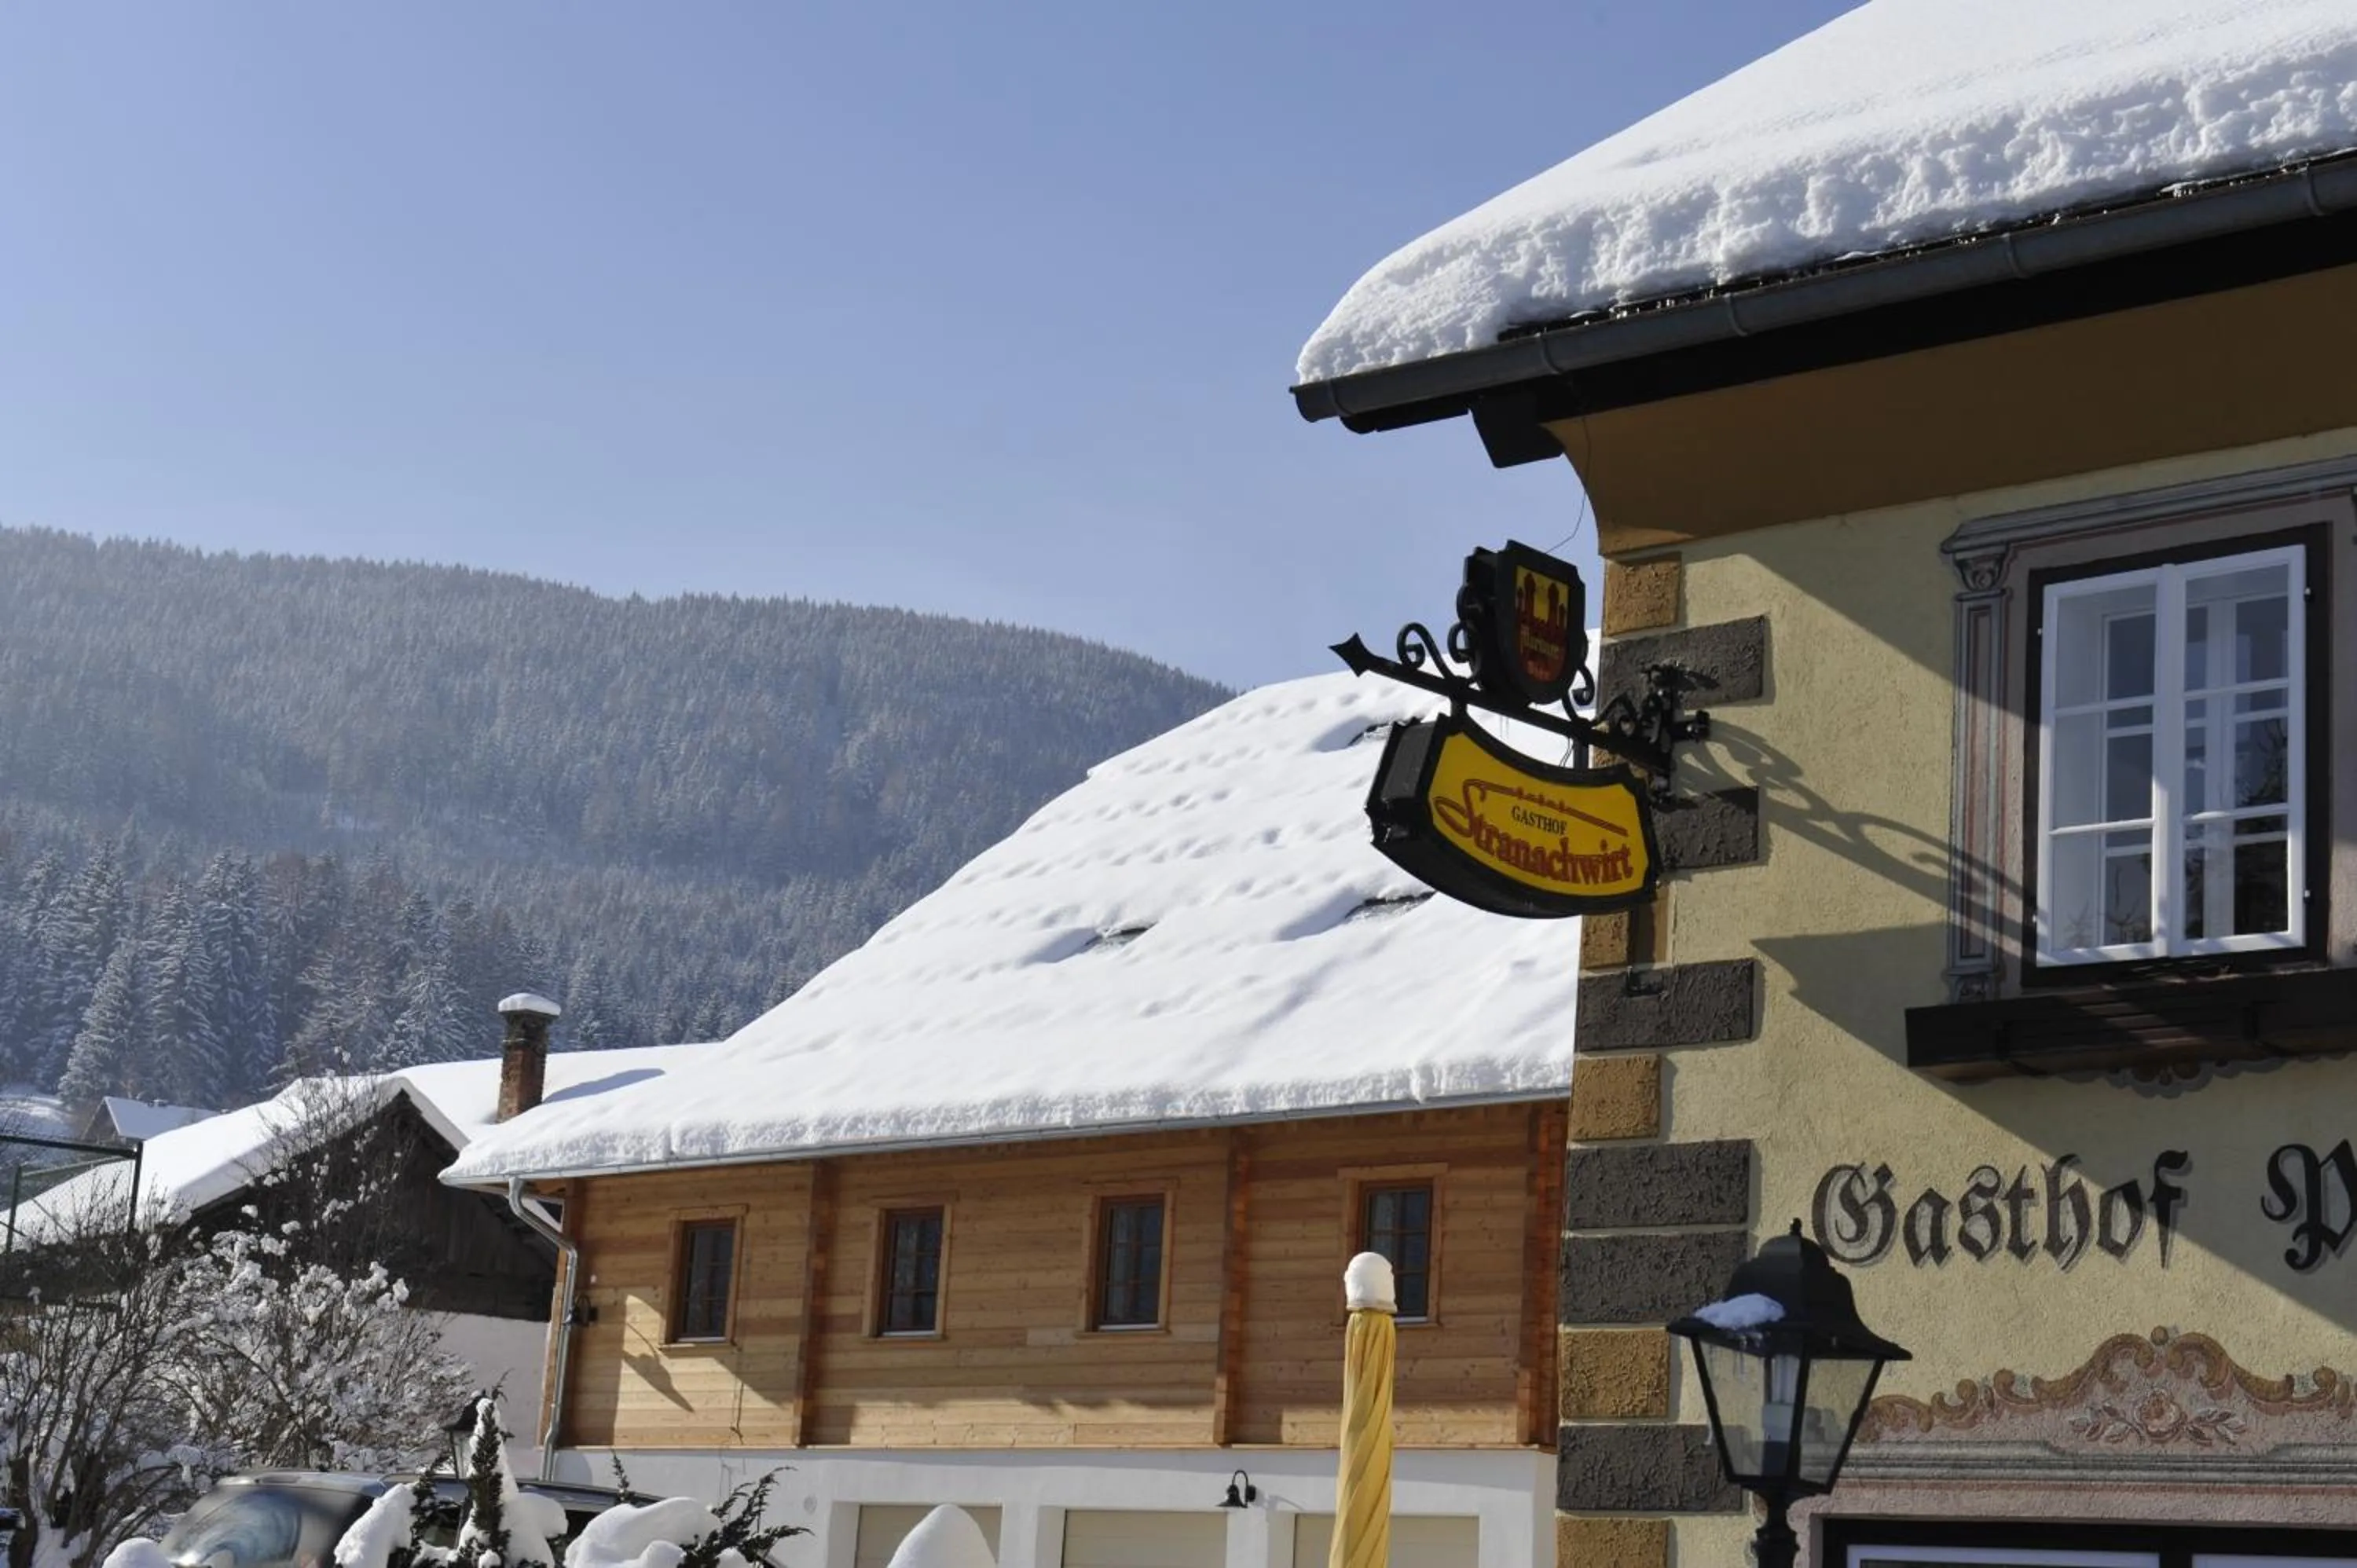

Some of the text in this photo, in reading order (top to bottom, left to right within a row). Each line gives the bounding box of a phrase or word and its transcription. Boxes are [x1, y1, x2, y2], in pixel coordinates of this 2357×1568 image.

[1434, 779, 1633, 885] Stranachwirt
[1511, 805, 1567, 836] GASTHOF
[1812, 1150, 2193, 1271] Gasthof
